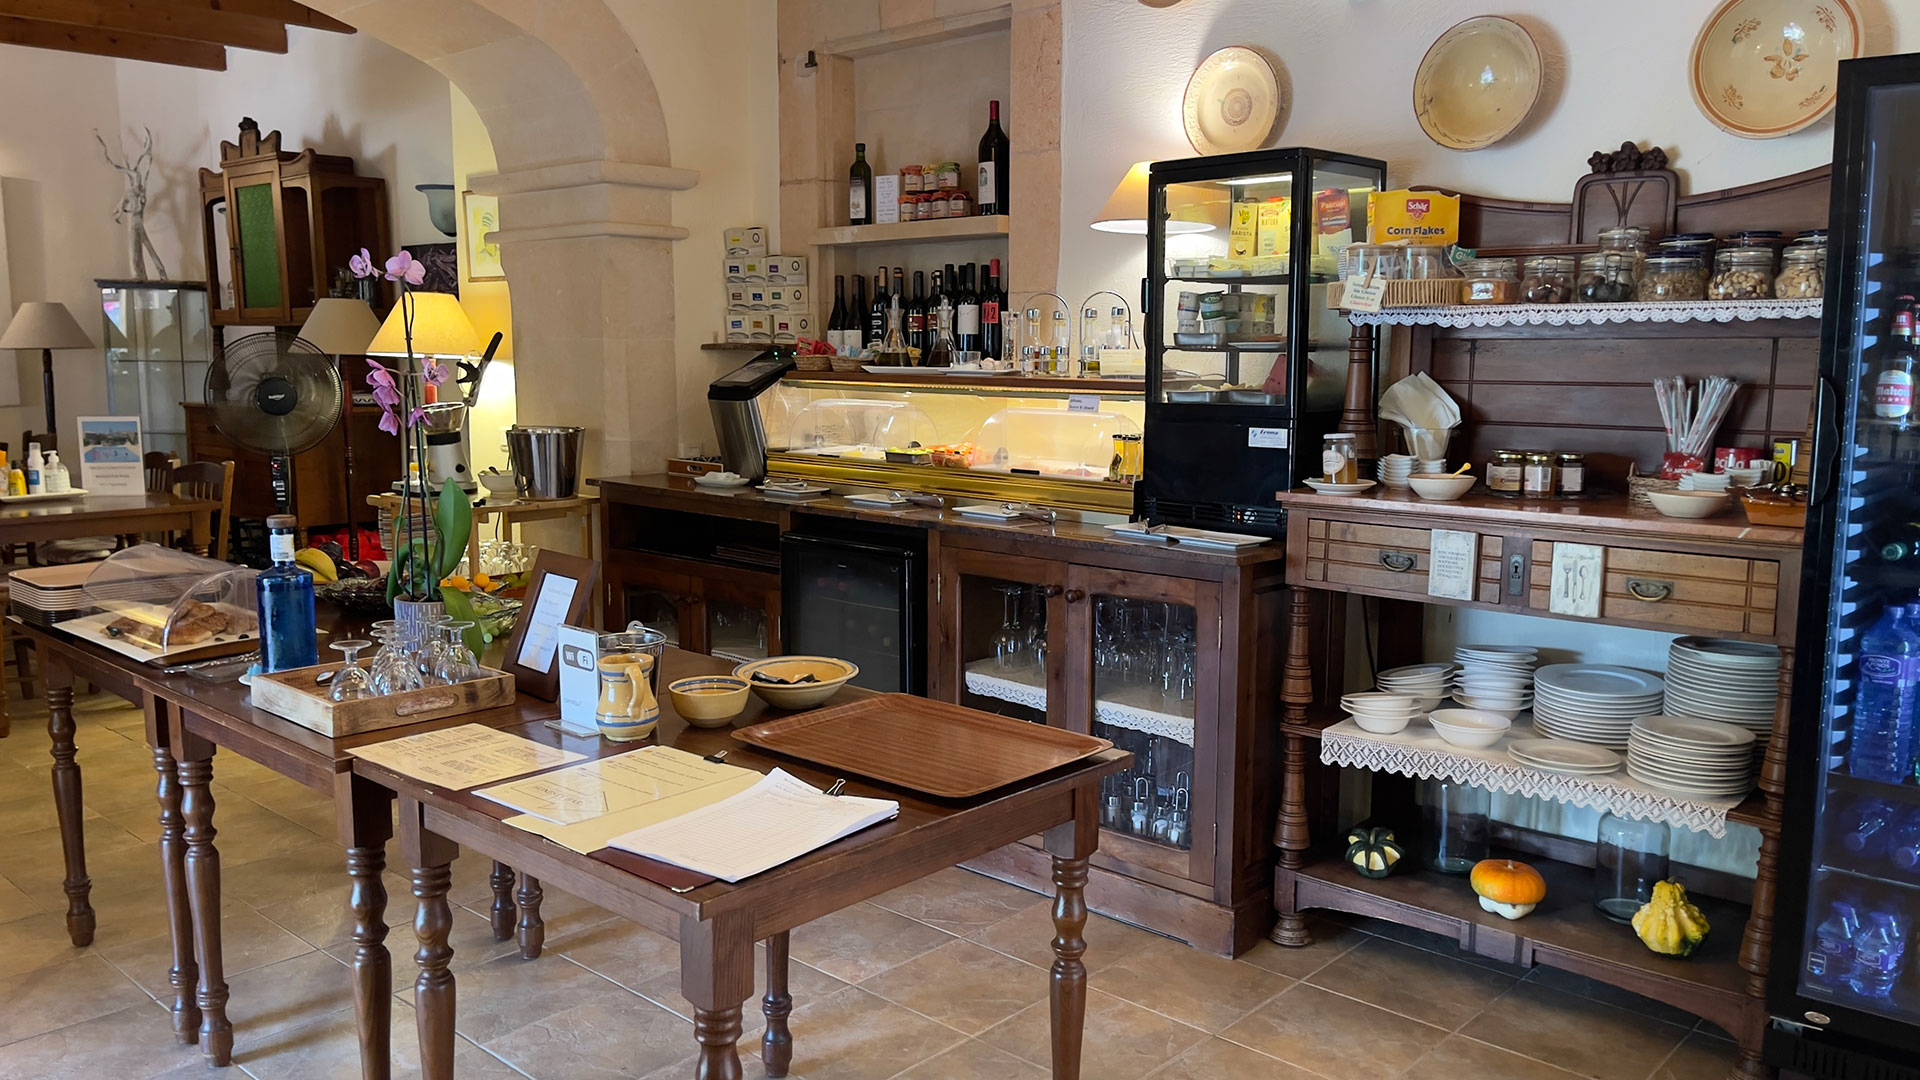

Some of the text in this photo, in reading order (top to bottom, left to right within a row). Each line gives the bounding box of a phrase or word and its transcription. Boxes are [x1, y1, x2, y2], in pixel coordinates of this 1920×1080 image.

[1387, 225, 1445, 235] Corn Flakes
[565, 650, 589, 665] Wi Fi
